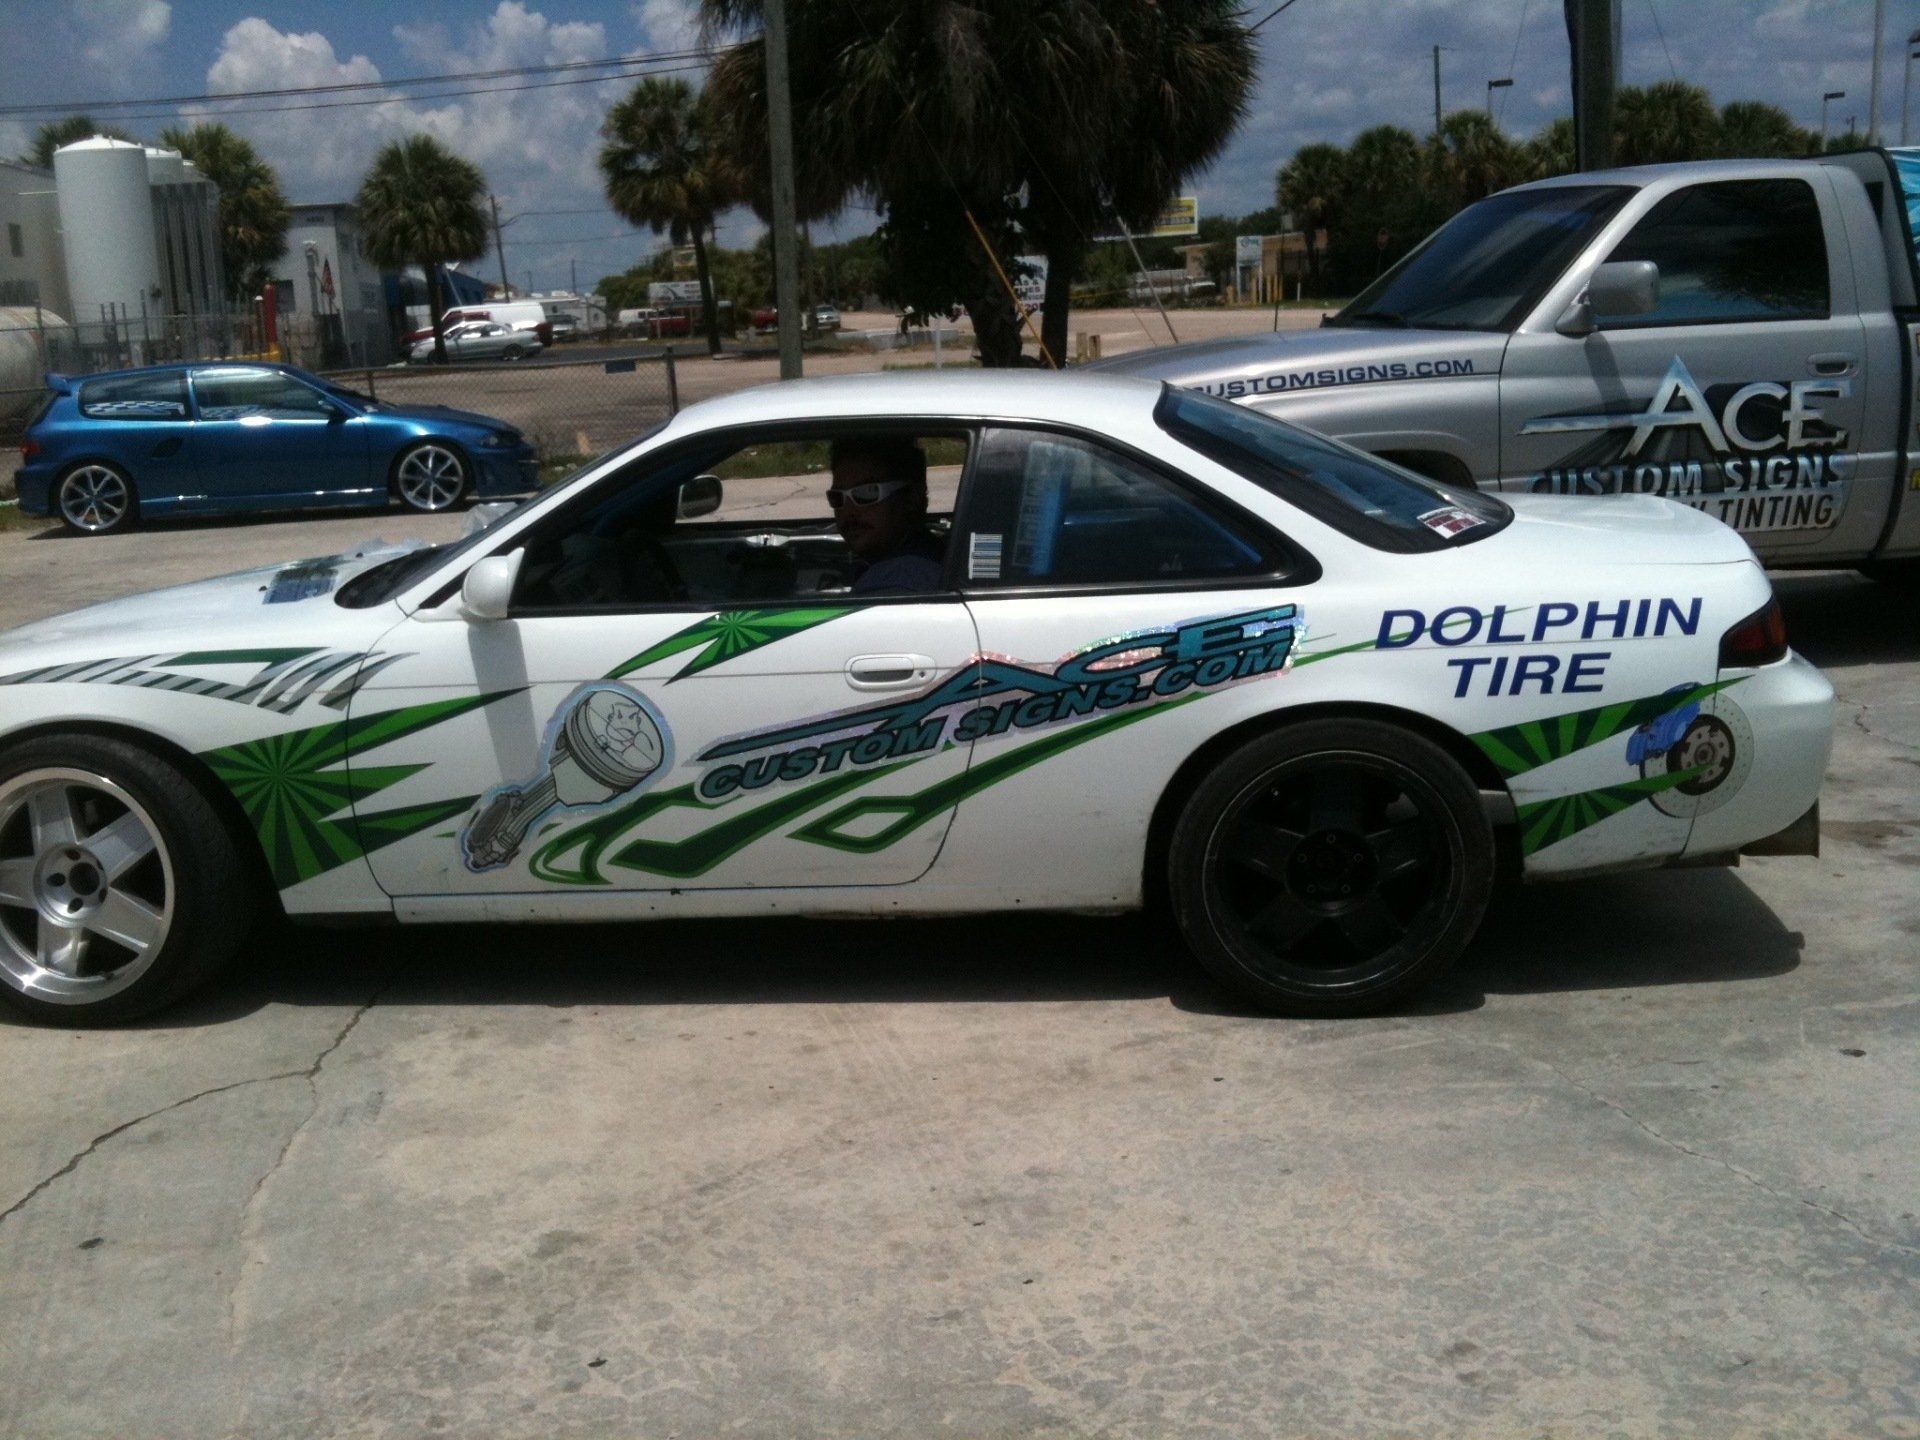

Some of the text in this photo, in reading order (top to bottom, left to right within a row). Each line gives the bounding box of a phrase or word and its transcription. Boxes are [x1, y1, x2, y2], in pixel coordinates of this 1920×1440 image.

[1517, 353, 1853, 459] ACE
[1526, 452, 1848, 498] CUSTOM SIGNS
[1713, 494, 1833, 531] TINTING
[1375, 597, 1703, 649] DOLPHIN
[698, 604, 1298, 761] ACE
[1447, 652, 1612, 698] TIRE
[700, 638, 1295, 798] CUSTOM SIGNS.COM
